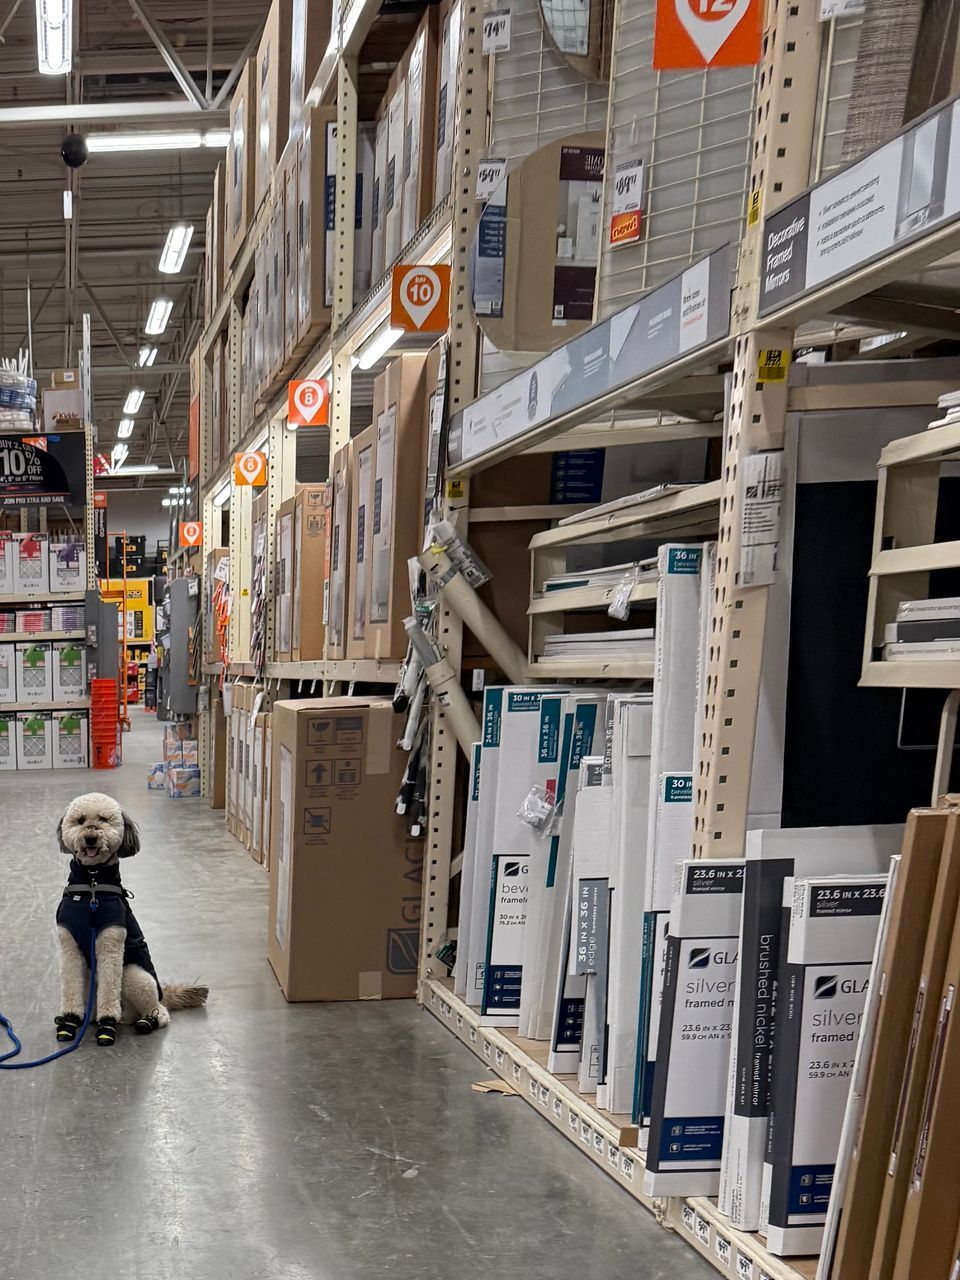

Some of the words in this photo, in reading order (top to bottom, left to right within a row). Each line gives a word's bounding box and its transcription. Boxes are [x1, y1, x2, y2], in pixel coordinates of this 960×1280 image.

[613, 216, 637, 238] new!
[767, 216, 806, 247] Decorative
[765, 245, 793, 273] Framed
[764, 269, 791, 294] Mirrors
[409, 285, 432, 302] 10
[304, 393, 314, 404] 8
[27, 466, 42, 475] OFF
[675, 551, 688, 560] 36
[542, 724, 549, 734] 36
[541, 748, 548, 758] 36
[672, 780, 685, 788] 30
[521, 865, 529, 874] G
[694, 870, 715, 878] 23.6
[692, 879, 714, 887] silver
[582, 887, 589, 898] IN
[817, 889, 840, 899] 23.6
[854, 890, 860, 898] X
[580, 901, 588, 918] 36
[581, 921, 588, 929] X
[581, 932, 587, 942] IN
[579, 946, 587, 962] 36
[588, 936, 597, 966] edge
[756, 934, 775, 999] brushed
[686, 978, 735, 994] silver
[684, 998, 725, 1009] framed
[812, 1009, 864, 1027] silver
[682, 1024, 701, 1032] 23.6
[754, 1004, 771, 1049] nickel
[811, 1031, 854, 1043] framed
[753, 1052, 762, 1080] framed
[809, 1061, 830, 1069] 23.6
[808, 1071, 825, 1079] 59.9
[752, 1082, 760, 1106] mirror
